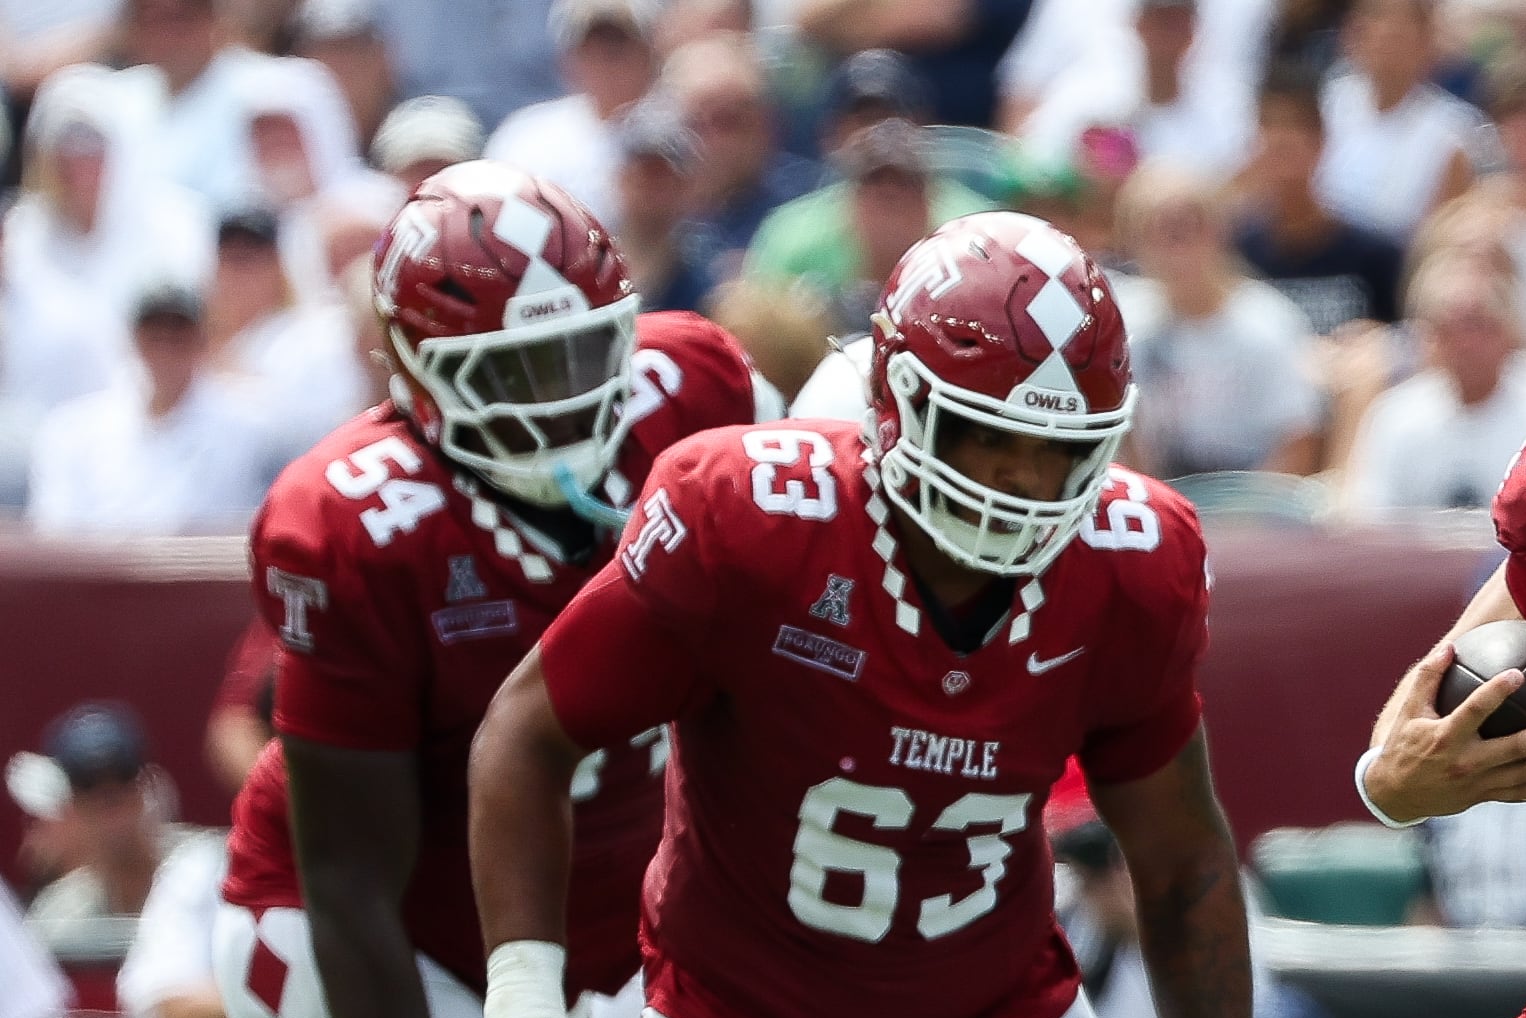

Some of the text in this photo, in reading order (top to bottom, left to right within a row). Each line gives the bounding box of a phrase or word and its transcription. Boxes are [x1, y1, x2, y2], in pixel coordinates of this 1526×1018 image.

[1025, 391, 1078, 412] OWLS
[324, 436, 446, 548] 54
[620, 488, 688, 583] T
[267, 566, 327, 653] T
[889, 726, 1000, 779] TEMPLE
[788, 776, 1033, 944] 63
